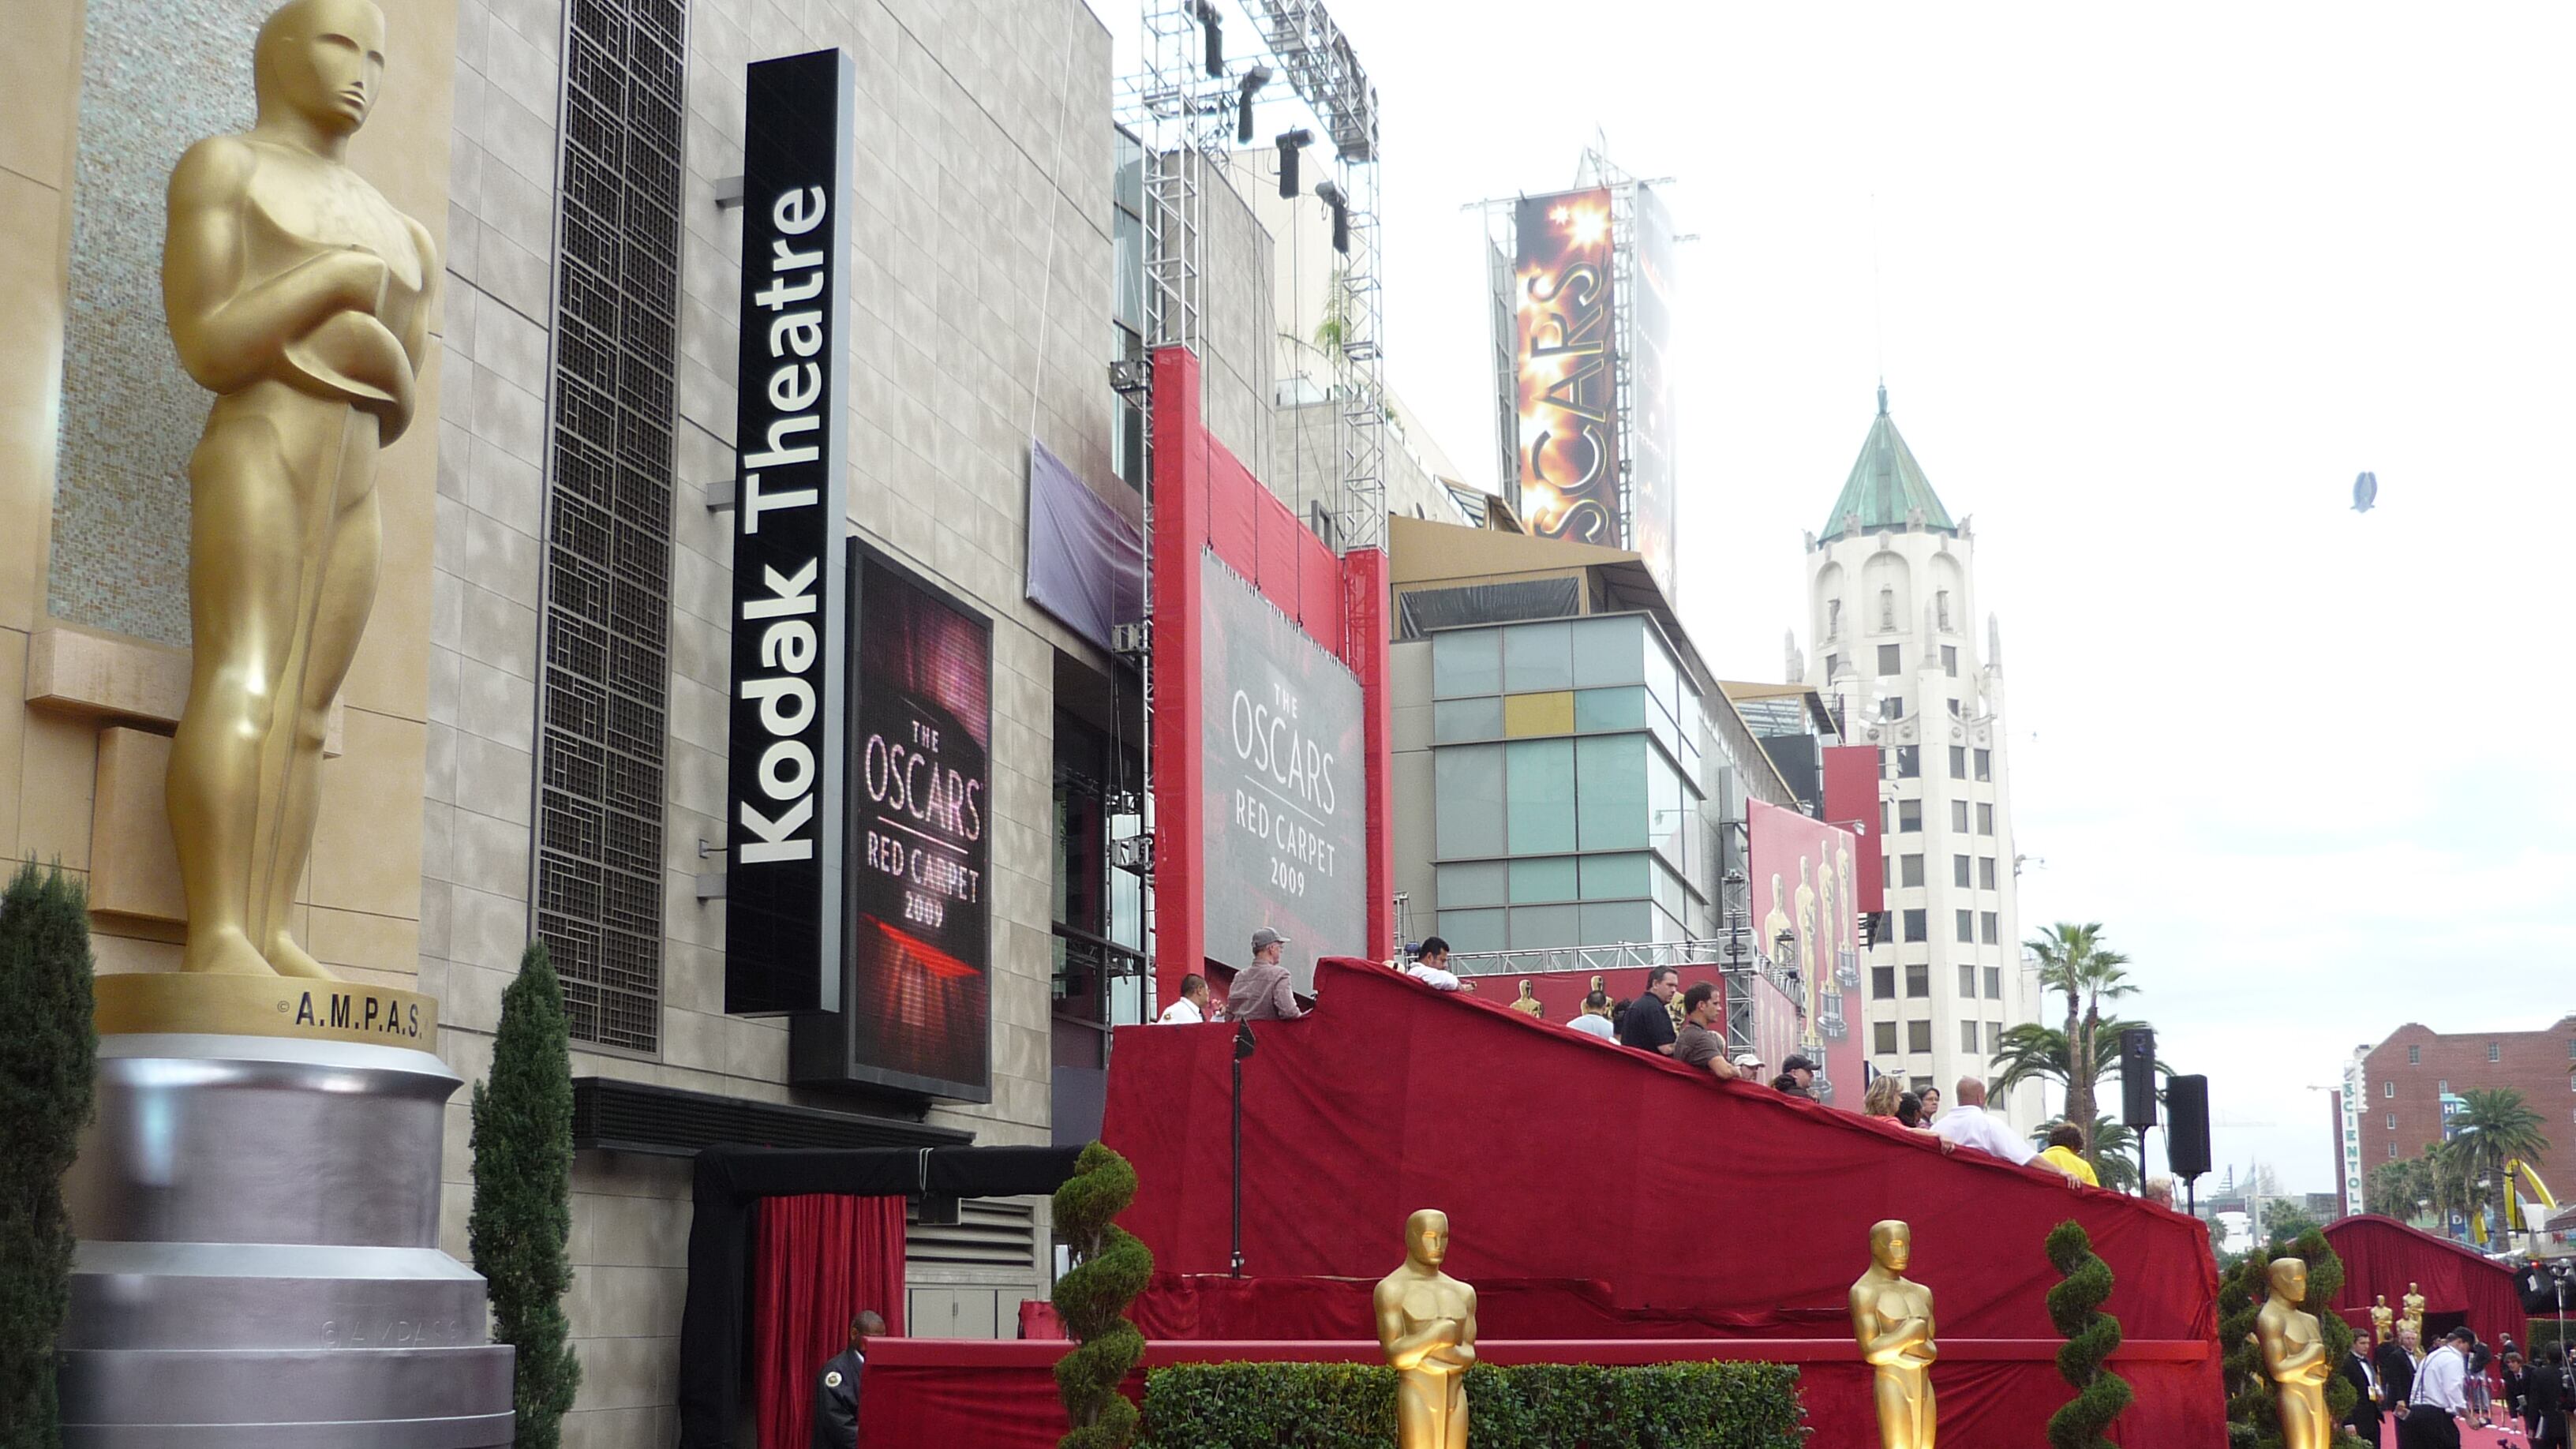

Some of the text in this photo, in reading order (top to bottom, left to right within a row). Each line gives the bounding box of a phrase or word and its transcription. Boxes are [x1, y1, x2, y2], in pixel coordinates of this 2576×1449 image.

[740, 185, 826, 864] Kodak Theatre
[912, 720, 939, 754] THE
[1273, 682, 1298, 719] THE
[866, 734, 980, 842] OSCARS
[1232, 689, 1335, 815] OSCARS
[868, 829, 979, 904] RED CARPET
[1236, 788, 1335, 878] RED CARPET
[904, 890, 944, 928] 2009
[1271, 856, 1305, 898] 2009
